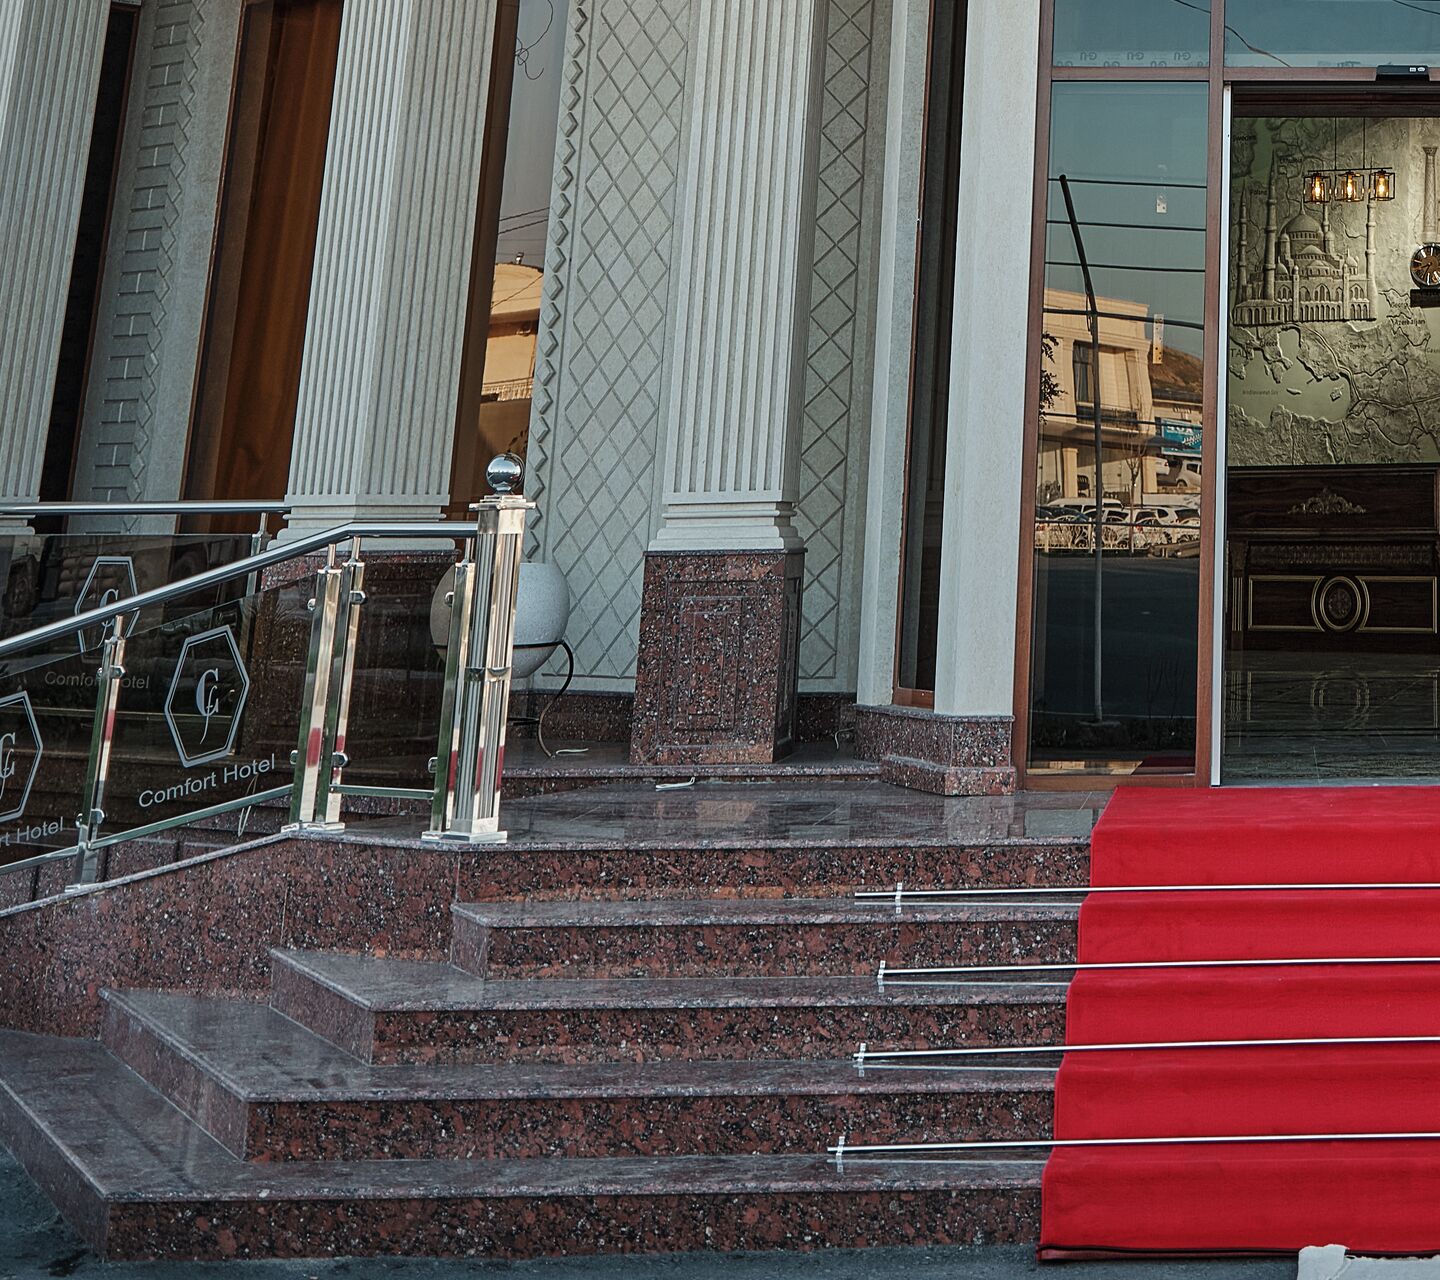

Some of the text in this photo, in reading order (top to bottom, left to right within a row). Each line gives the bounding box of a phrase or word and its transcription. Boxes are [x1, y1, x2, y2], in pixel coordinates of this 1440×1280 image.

[45, 671, 149, 689] Comfor otel
[138, 752, 275, 808] Comfort Hotel
[16, 816, 63, 843] Hotel
